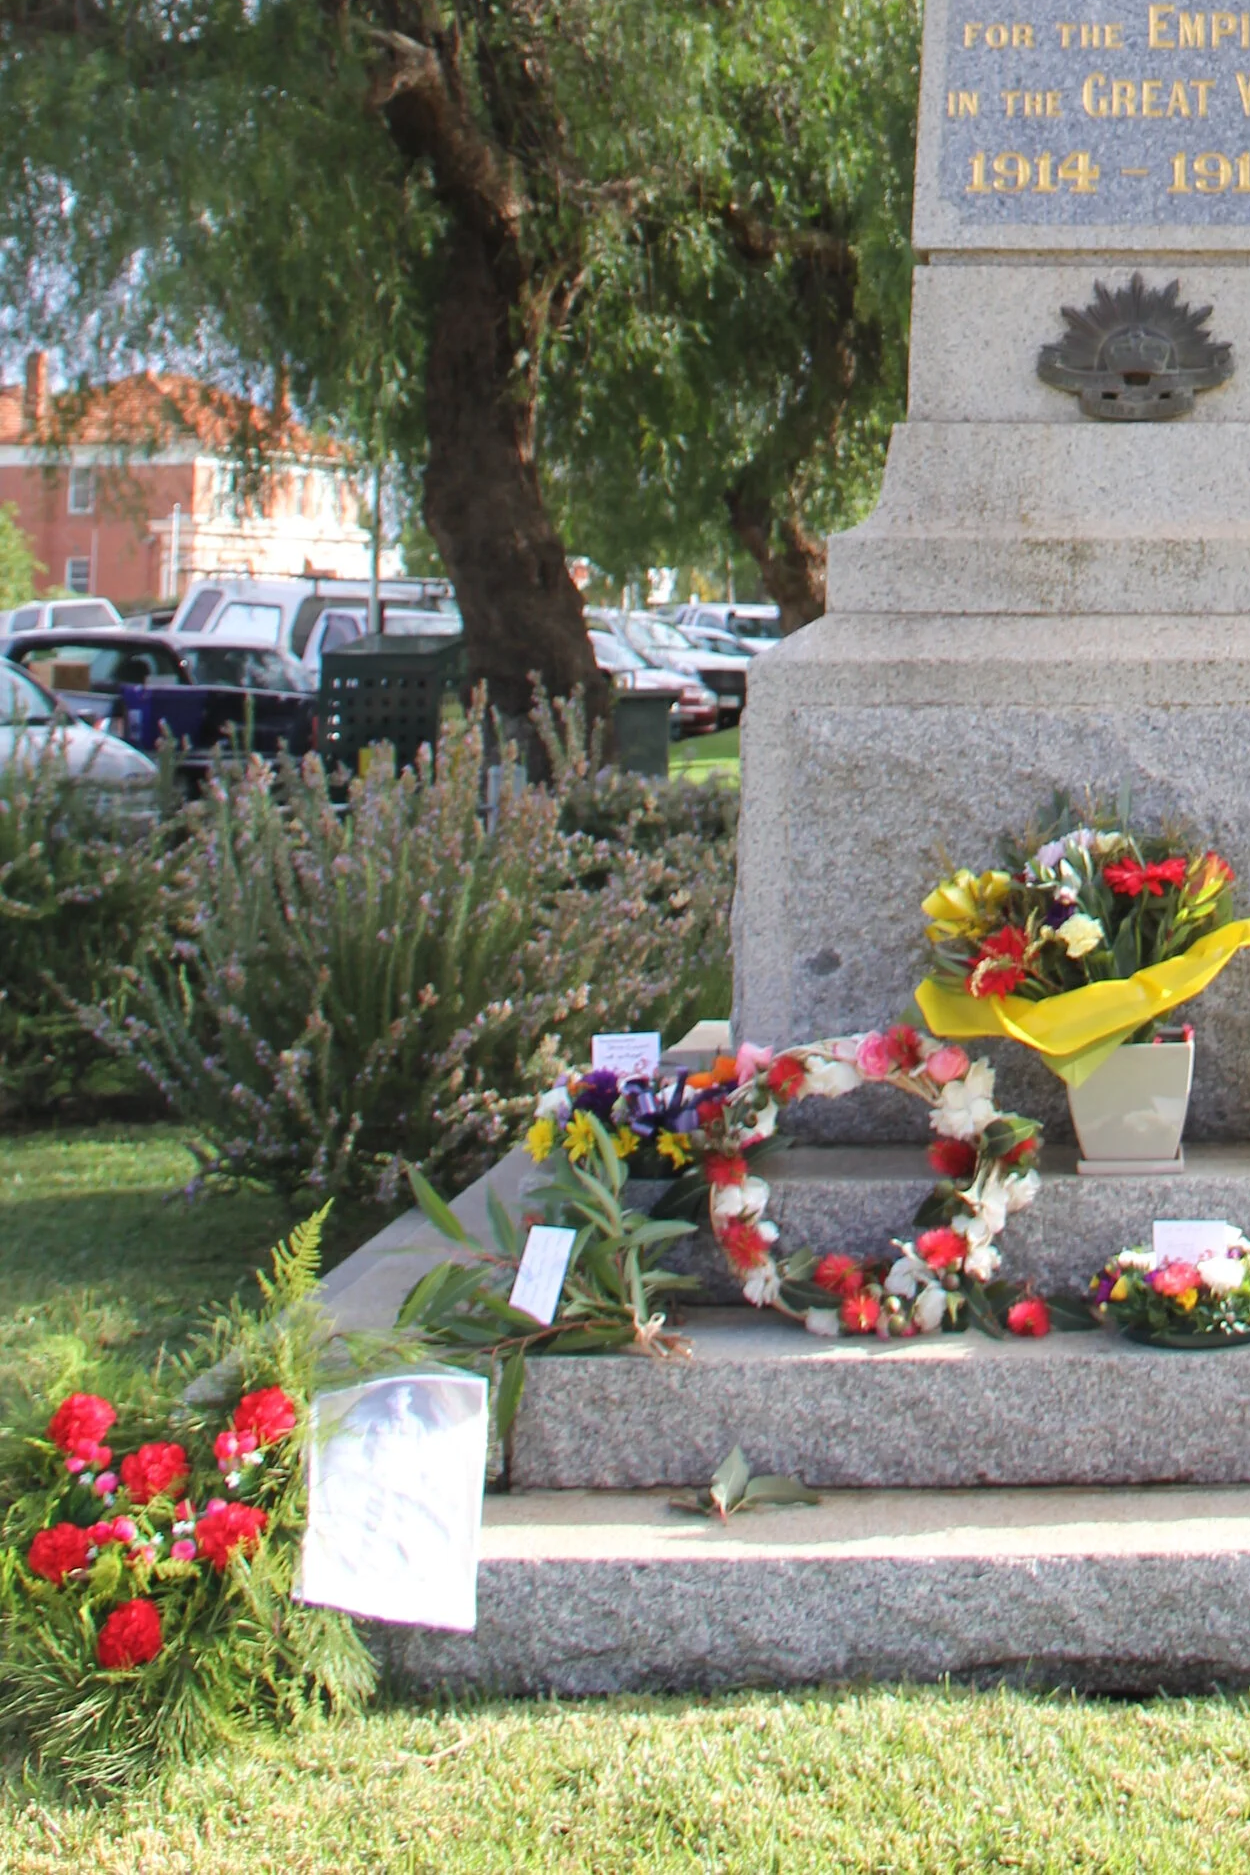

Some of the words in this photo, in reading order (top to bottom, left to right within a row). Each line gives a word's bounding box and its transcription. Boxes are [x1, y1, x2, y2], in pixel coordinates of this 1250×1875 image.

[962, 24, 1035, 48] FOR
[1055, 24, 1123, 49] THE
[947, 91, 979, 117] IN
[1002, 91, 1062, 117] THE
[1081, 73, 1215, 119] GREAT
[965, 151, 1099, 193] 1914
